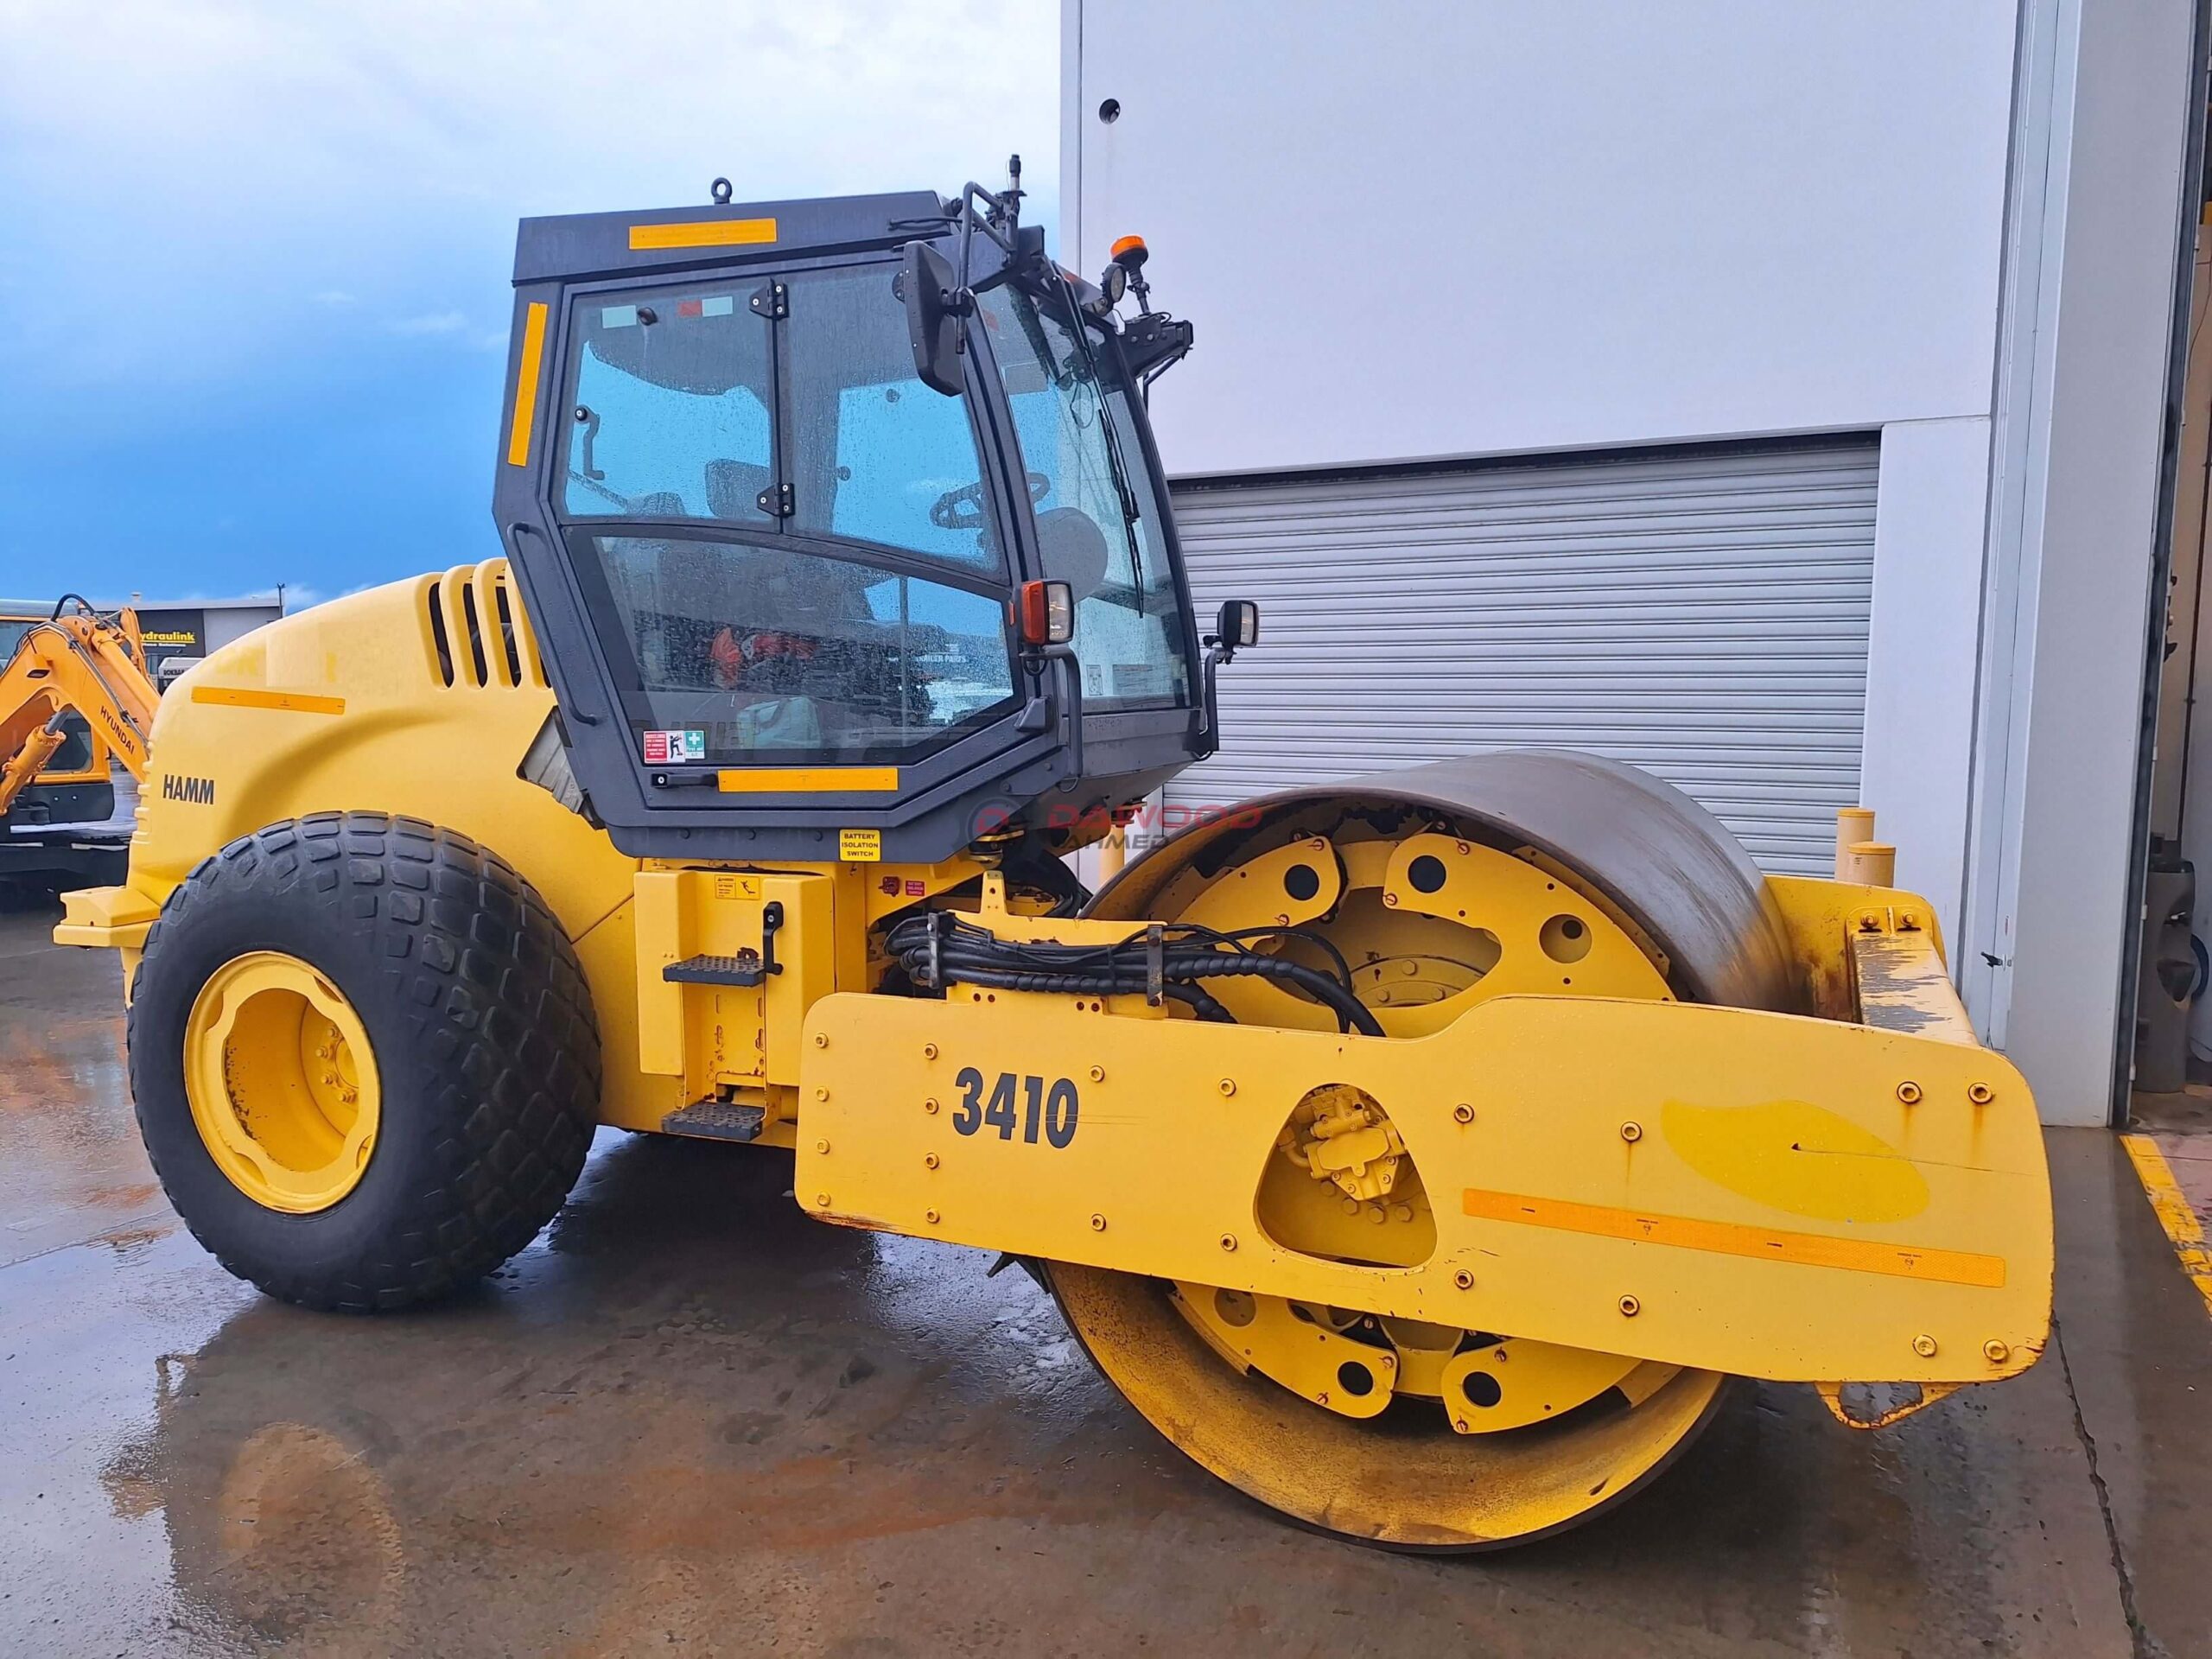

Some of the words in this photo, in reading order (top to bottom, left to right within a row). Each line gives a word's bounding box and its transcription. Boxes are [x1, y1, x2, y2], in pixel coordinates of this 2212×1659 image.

[140, 632, 195, 641] ydraulink
[100, 705, 135, 754] HYUNDAI
[162, 774, 214, 805] HAMM
[952, 1066, 1079, 1149] 3410
